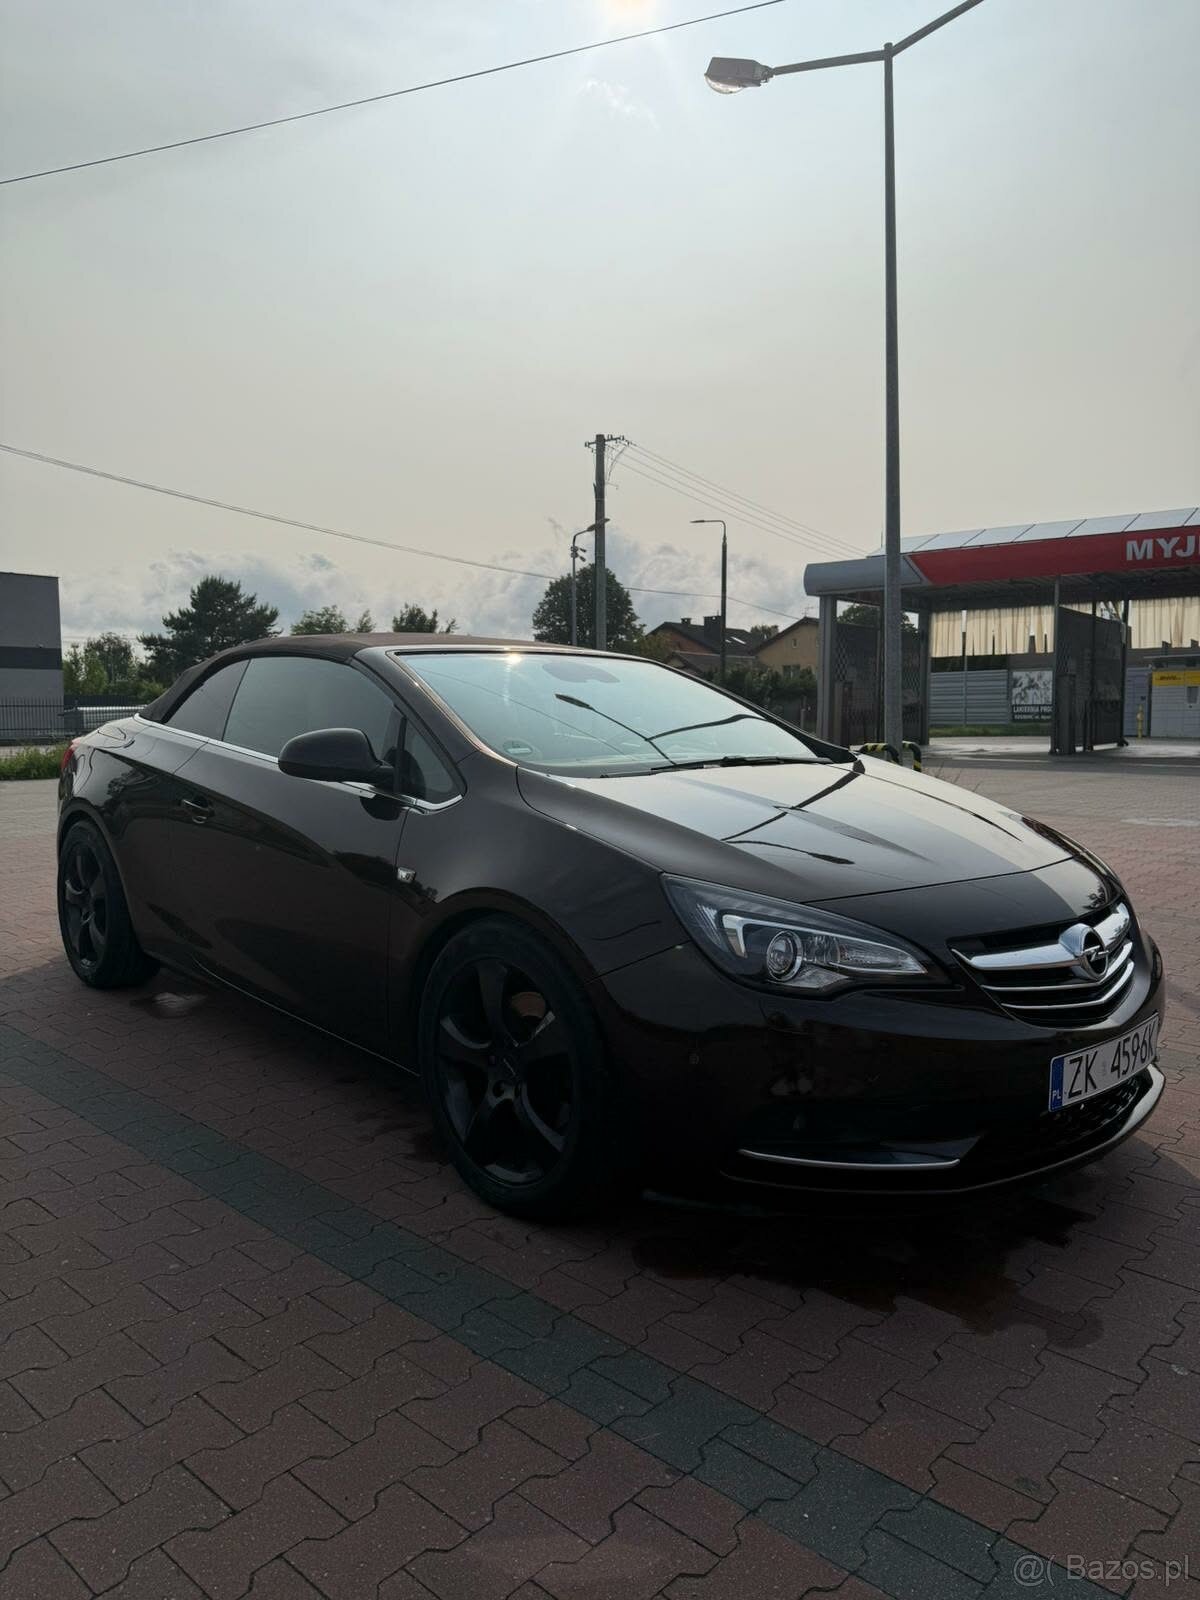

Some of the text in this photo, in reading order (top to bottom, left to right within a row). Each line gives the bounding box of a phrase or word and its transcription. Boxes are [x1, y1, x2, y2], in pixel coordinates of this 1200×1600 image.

[1126, 535, 1200, 561] MYJ
[1068, 1050, 1098, 1099] ZK
[1052, 1089, 1062, 1102] PL
